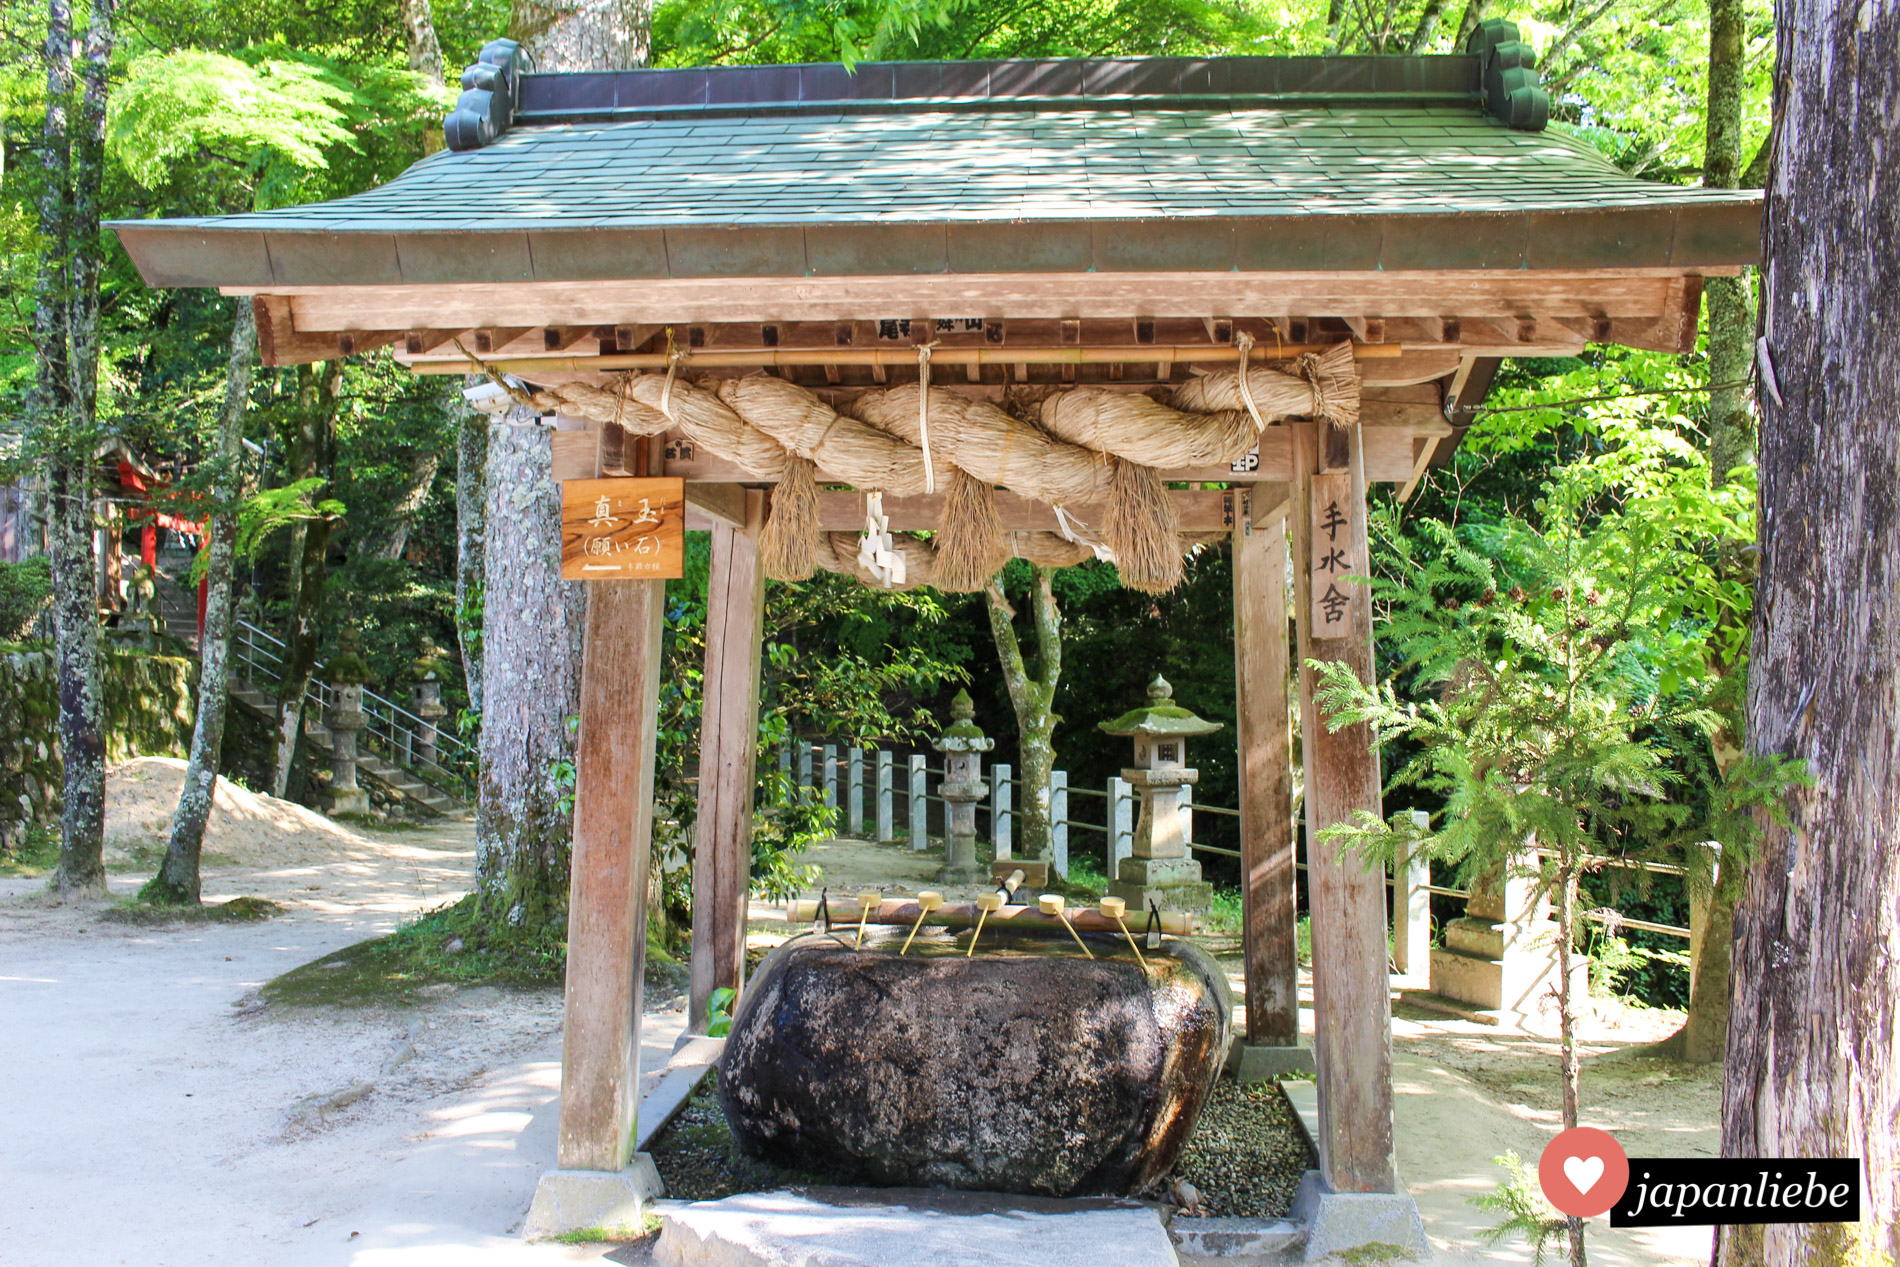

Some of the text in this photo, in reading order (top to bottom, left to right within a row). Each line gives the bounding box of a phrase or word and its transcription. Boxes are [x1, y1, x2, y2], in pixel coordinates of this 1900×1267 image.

[588, 494, 659, 528] 真玉
[584, 536, 661, 557] (願い石)
[1315, 500, 1351, 625] 手水舎
